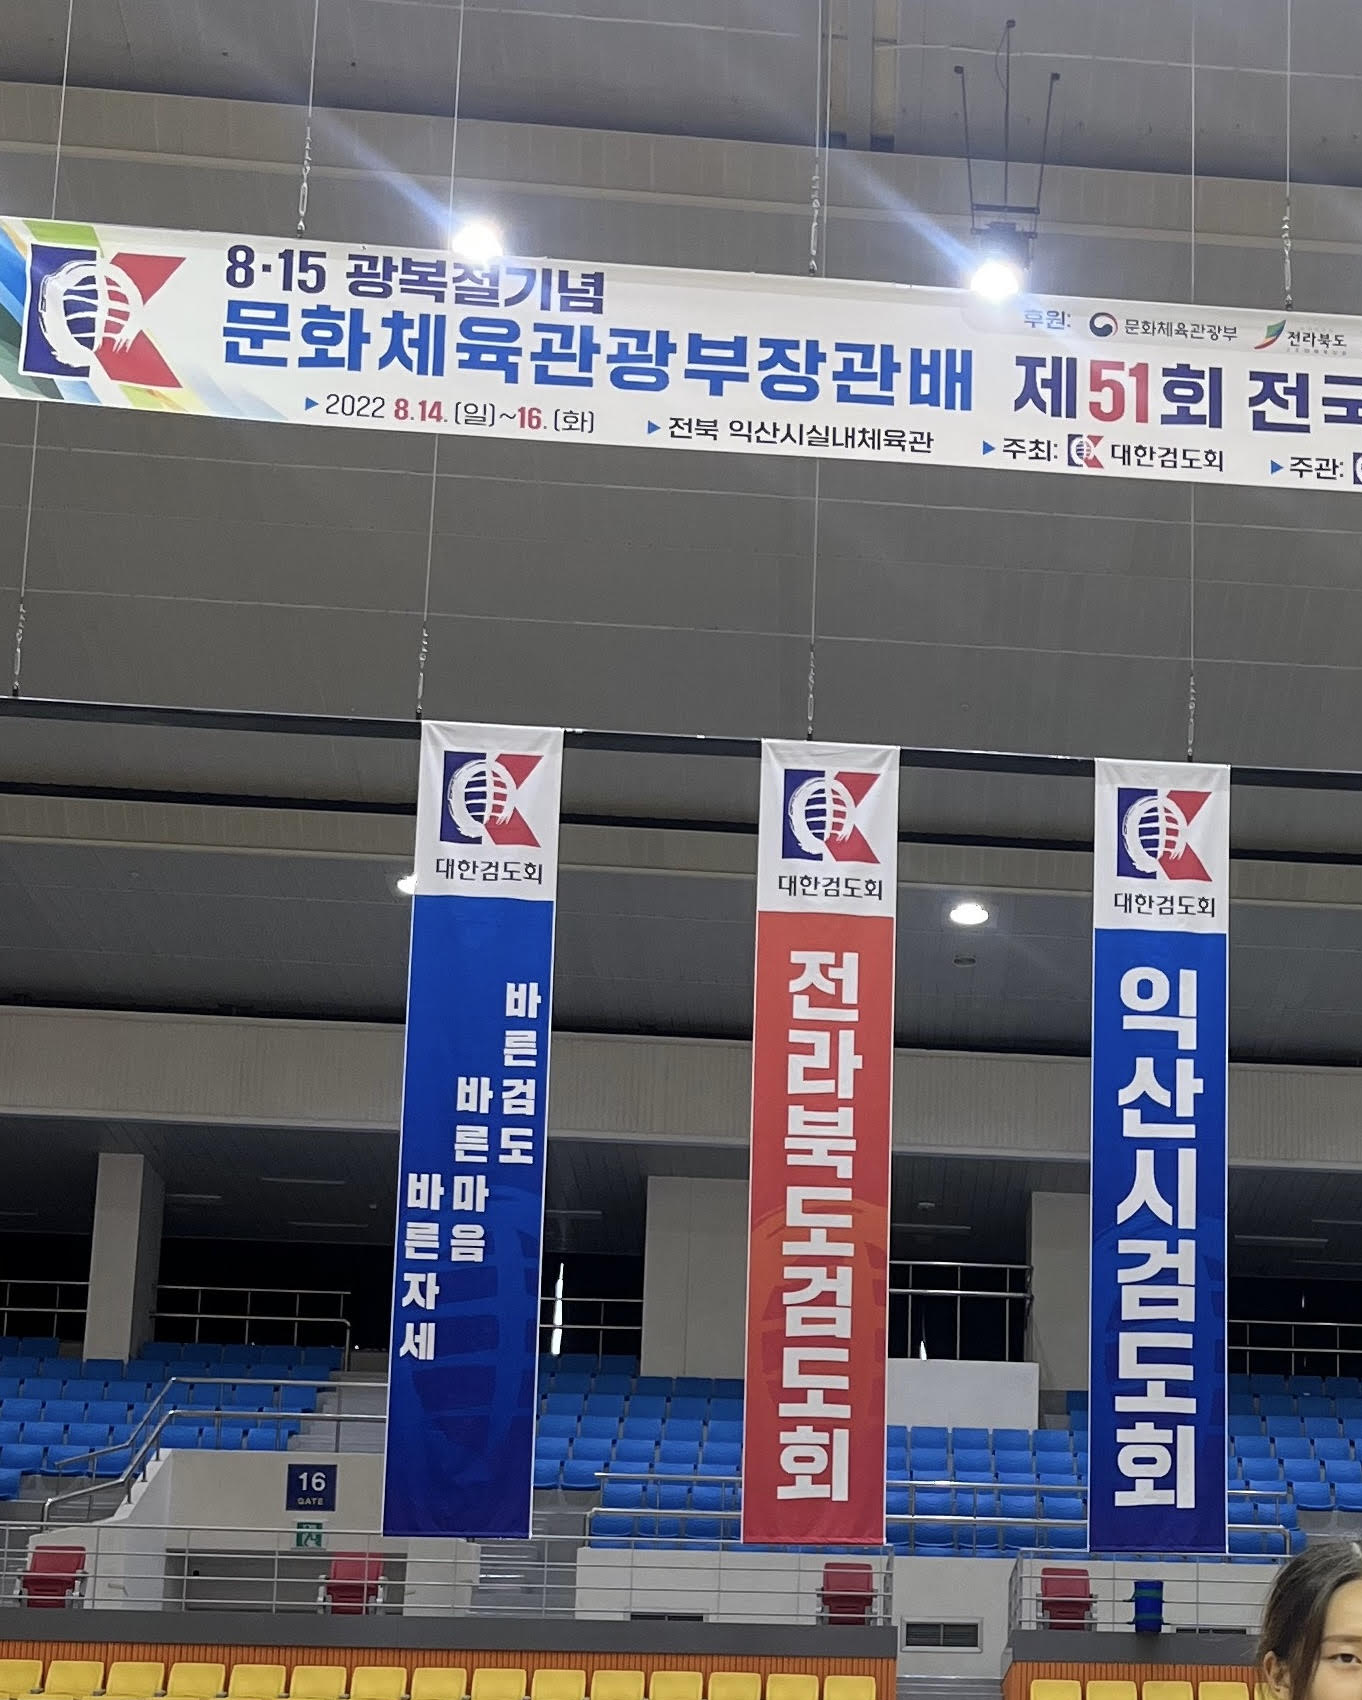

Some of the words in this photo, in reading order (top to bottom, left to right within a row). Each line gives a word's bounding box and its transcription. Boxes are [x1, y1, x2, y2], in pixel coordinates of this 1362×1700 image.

[346, 253, 604, 315] 광복절기념
[1023, 309, 1072, 331] 후원:
[1124, 318, 1238, 342] 문화체육관광부
[1287, 331, 1347, 349] 전라북도
[222, 301, 973, 411] 문화체육관광부장관배
[325, 393, 385, 419] 2022
[1013, 355, 1223, 430] 제51회
[668, 416, 719, 441] 전북
[729, 418, 934, 453] 익산시실내체육관
[1002, 437, 1058, 462] 주최:
[1111, 442, 1224, 473] 대한검도회
[1289, 455, 1344, 481] 주관:
[435, 857, 543, 885] 대한검도회
[778, 874, 884, 901] 대한검도회
[1114, 892, 1216, 918] 대한검도회
[776, 950, 863, 1502] 전라북도검도회
[1114, 966, 1204, 1509] 익산시검도회
[298, 1471, 326, 1491] 16
[296, 1497, 325, 1506] GATE
